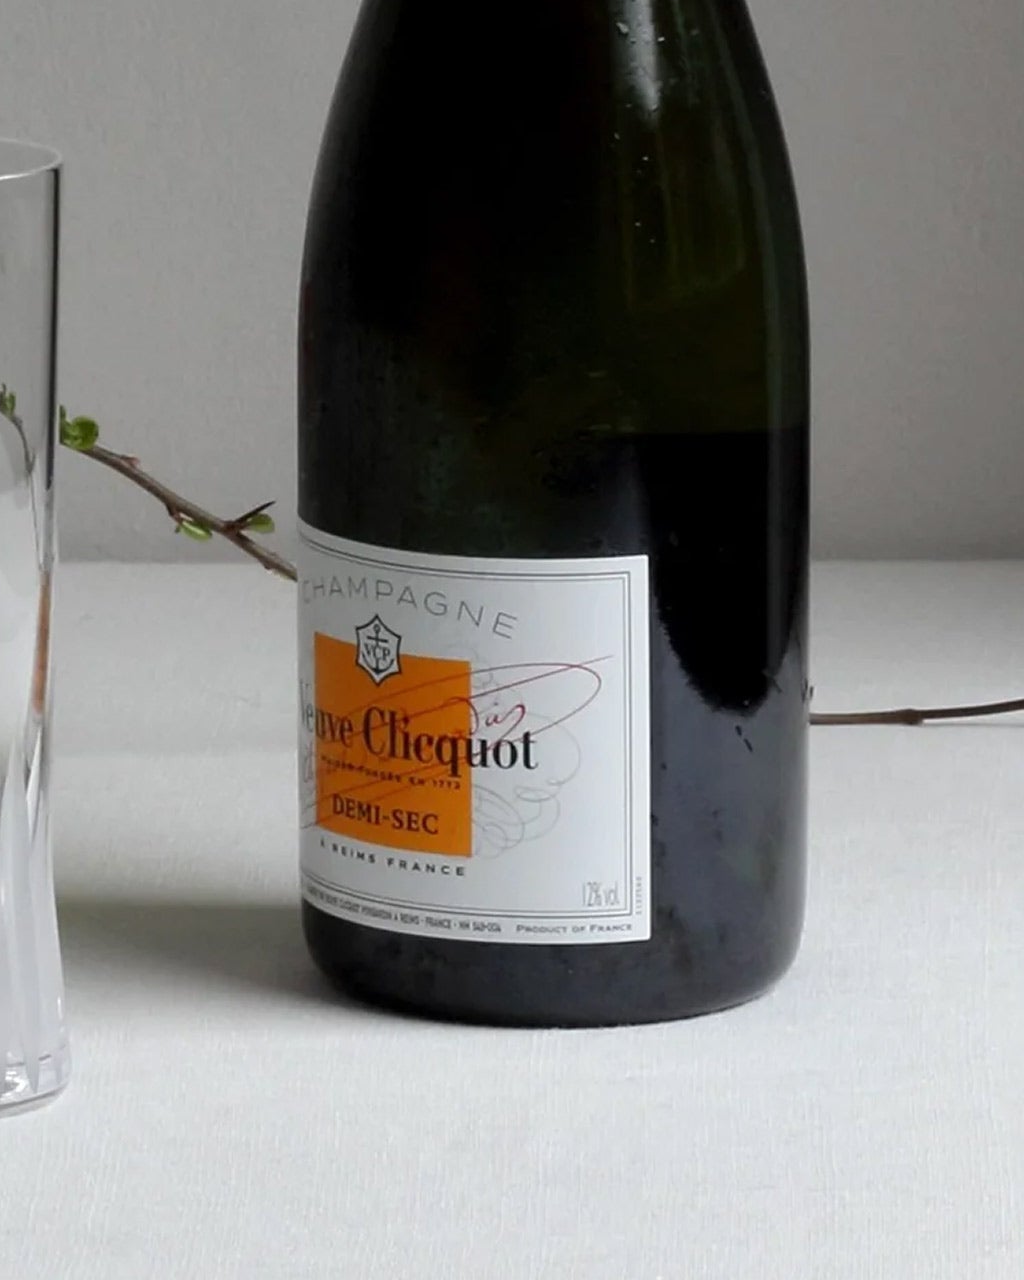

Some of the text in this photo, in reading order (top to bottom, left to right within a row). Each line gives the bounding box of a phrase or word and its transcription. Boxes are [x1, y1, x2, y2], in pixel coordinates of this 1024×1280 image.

[303, 575, 518, 640] CHAMPAGNE
[363, 706, 539, 778] Clicquot
[332, 792, 439, 835] DEMI-SEC
[332, 842, 376, 864] REIMS
[387, 856, 466, 877] FRANCE
